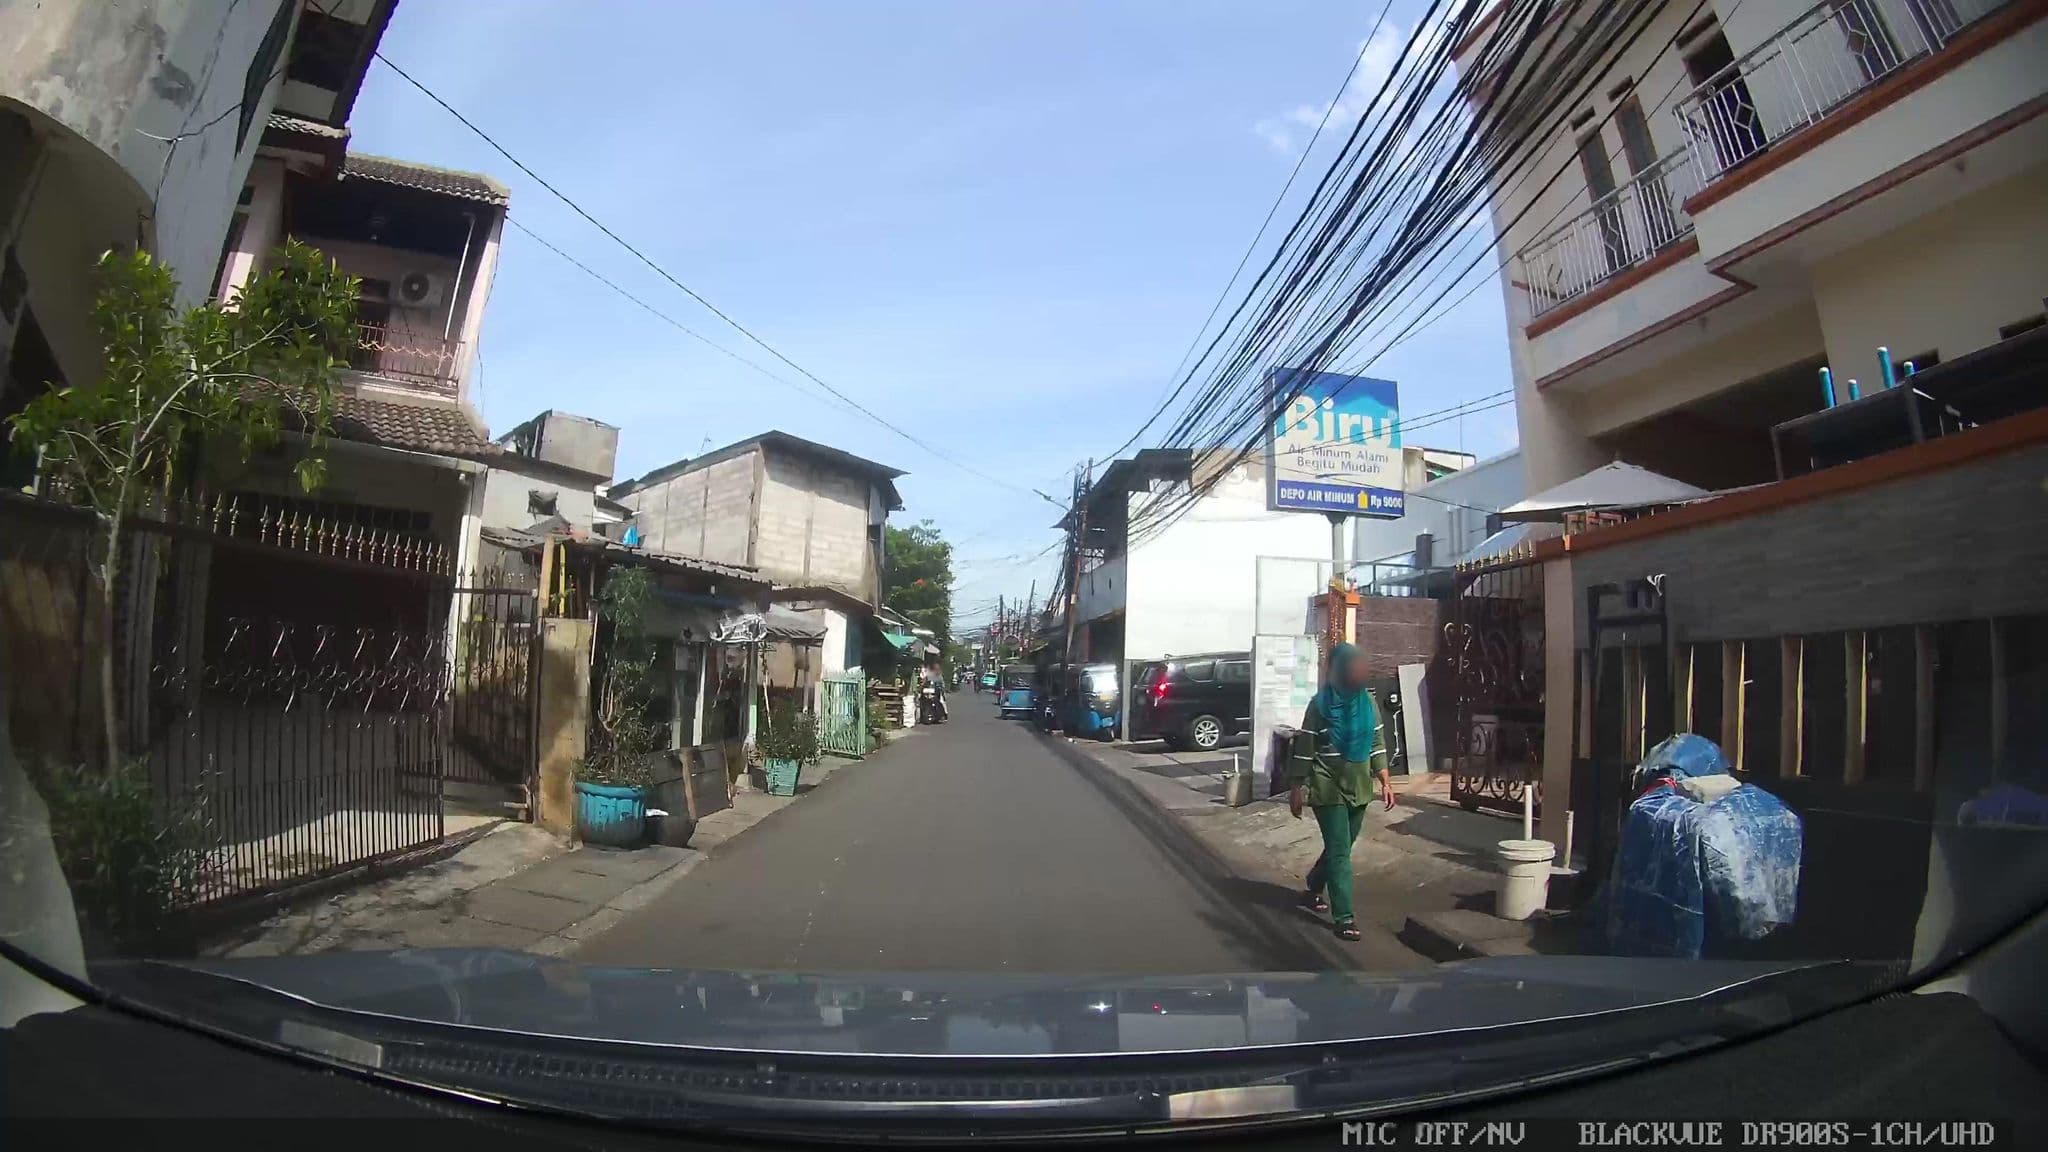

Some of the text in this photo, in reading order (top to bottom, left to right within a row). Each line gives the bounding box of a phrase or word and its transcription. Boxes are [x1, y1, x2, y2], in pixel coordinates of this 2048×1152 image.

[1285, 395, 1392, 446] Biru
[1289, 443, 1389, 463] Air Minum Alami
[1297, 456, 1380, 473] Begitu Mudah
[1280, 488, 1403, 508] DEPO AIR MINUM Rp 9000
